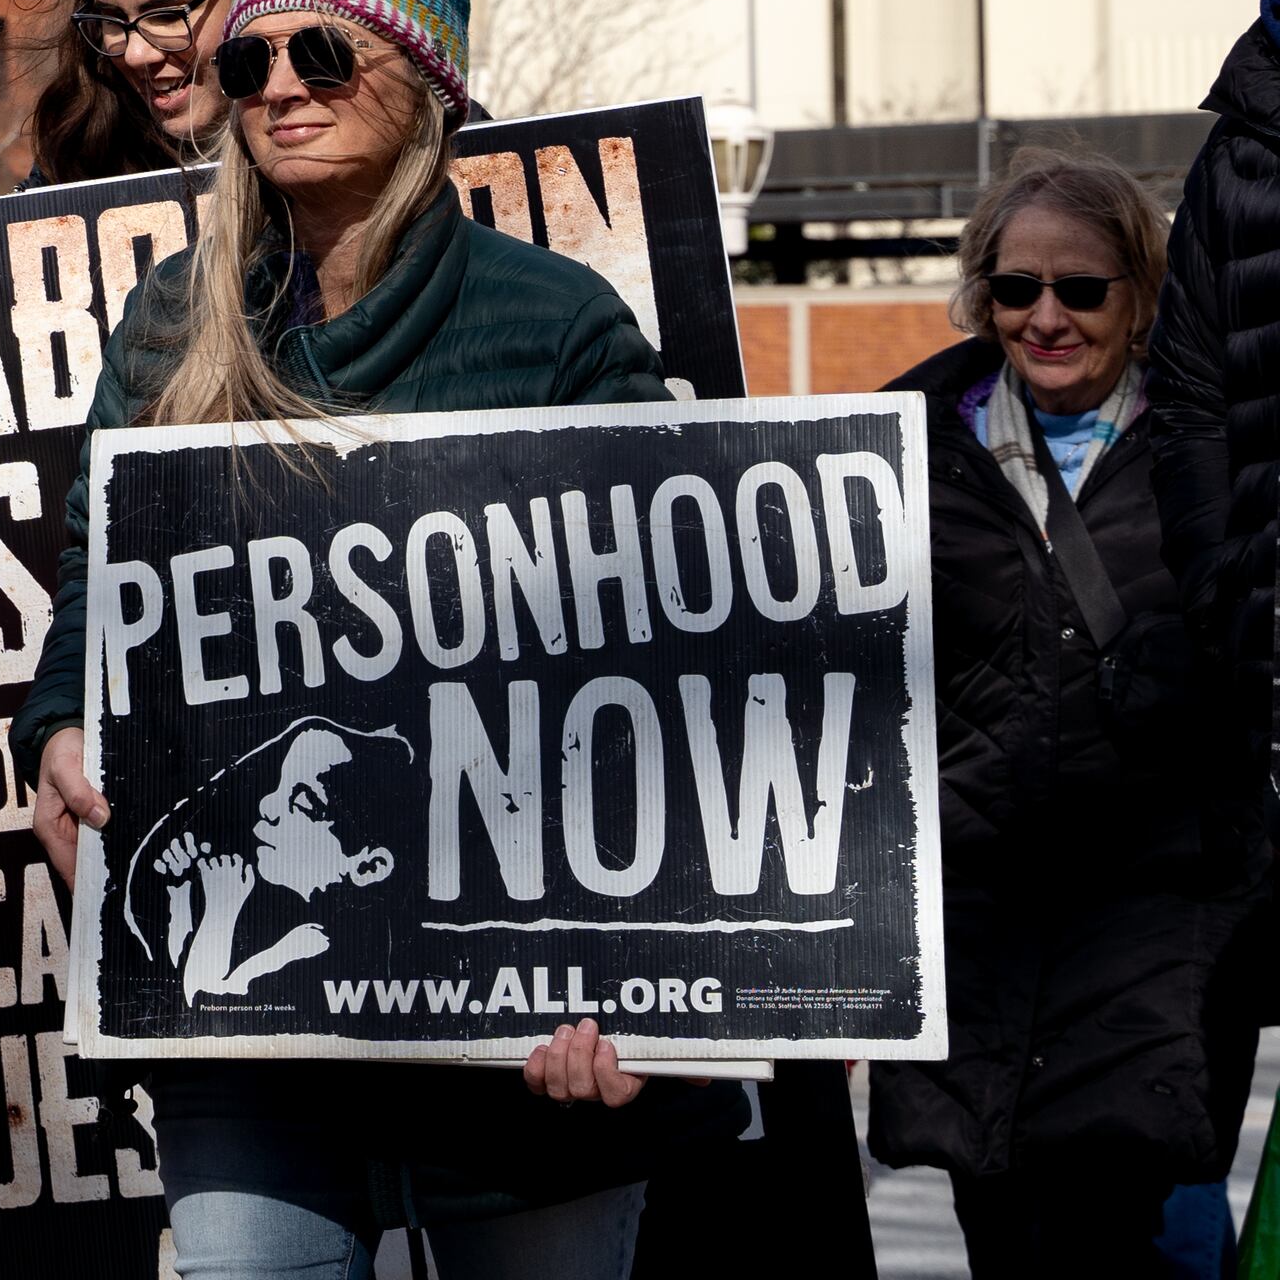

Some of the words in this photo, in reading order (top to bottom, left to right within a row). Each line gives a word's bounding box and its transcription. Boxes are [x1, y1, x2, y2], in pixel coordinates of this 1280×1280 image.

[103, 451, 910, 717] PERSONHOOD
[427, 671, 856, 901] NOW
[826, 995, 847, 1003] greatly
